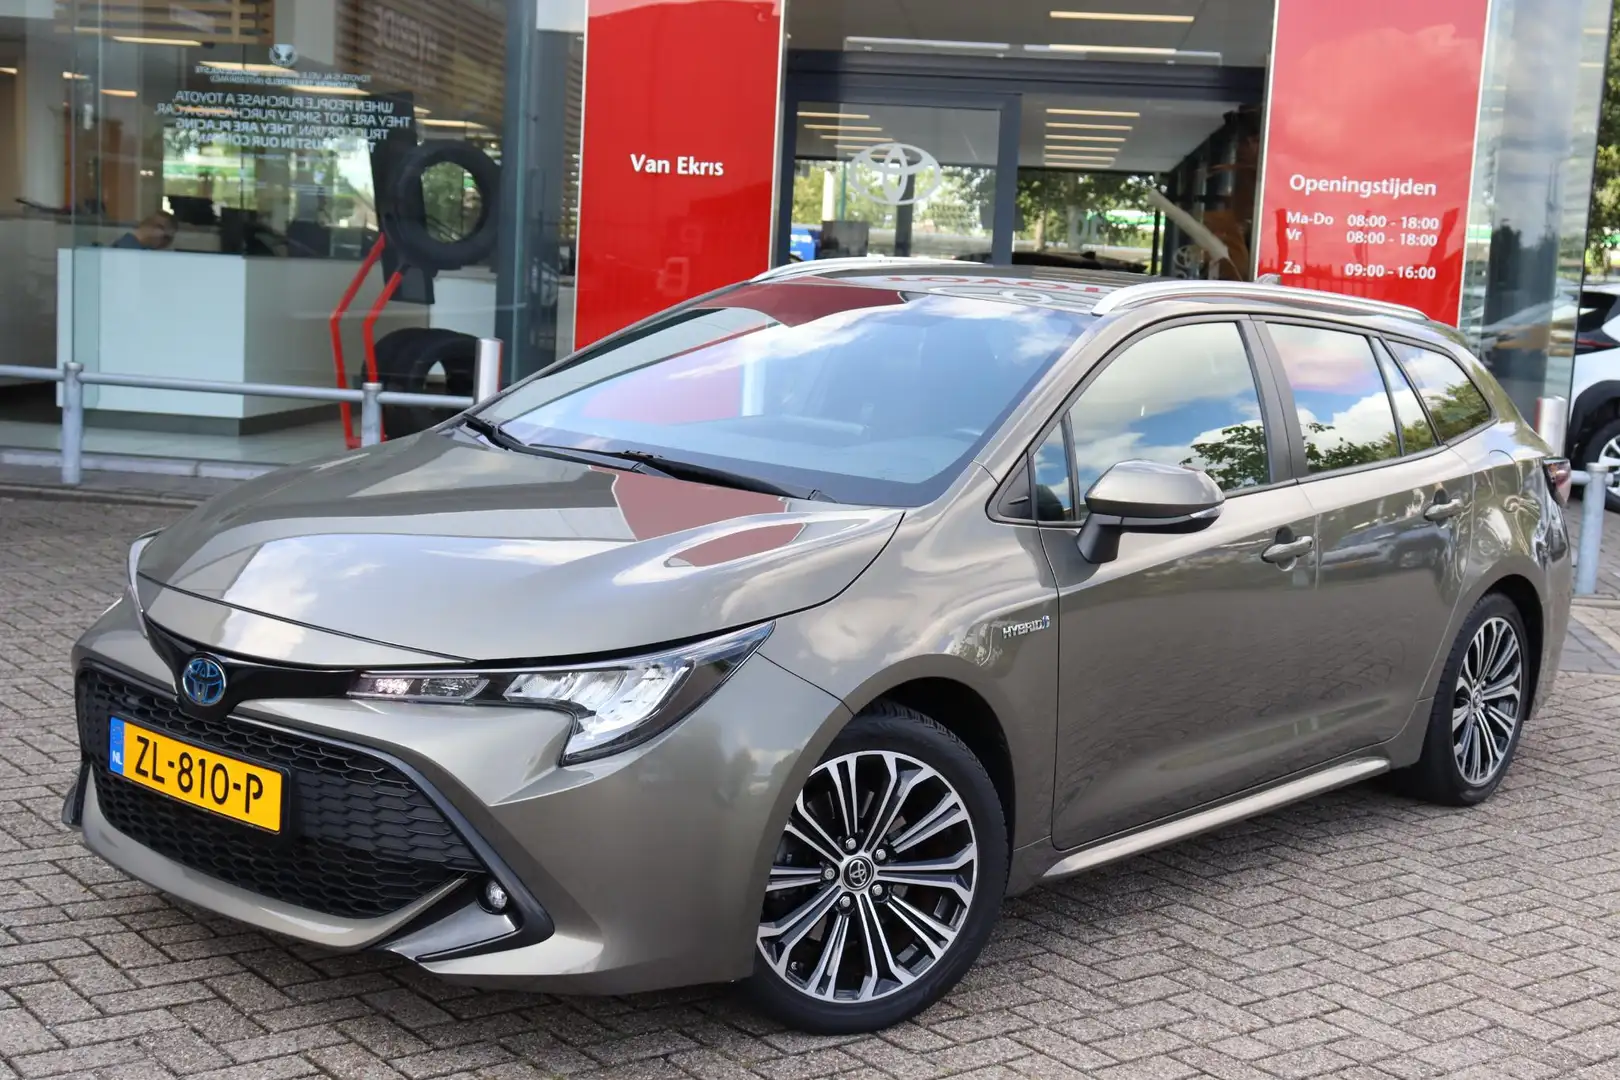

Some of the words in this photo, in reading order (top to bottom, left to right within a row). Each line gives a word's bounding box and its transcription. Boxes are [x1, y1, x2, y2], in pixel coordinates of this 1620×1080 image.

[629, 153, 671, 174] Van
[677, 156, 724, 176] Ekris
[1289, 173, 1437, 199] Openingstijden
[1286, 211, 1334, 226] Ma-Do
[1347, 214, 1387, 227] 08:00
[1400, 216, 1439, 230] 18:00
[1285, 228, 1302, 241] Vr
[1346, 231, 1385, 244] 08:00
[1399, 233, 1438, 246] 18:00
[1283, 261, 1301, 274] Za
[1344, 263, 1385, 277] 09:00
[1397, 266, 1437, 280] 16:00
[1003, 619, 1045, 639] HYBRID
[112, 750, 123, 765] NL
[135, 735, 264, 814] ZL-810-P
